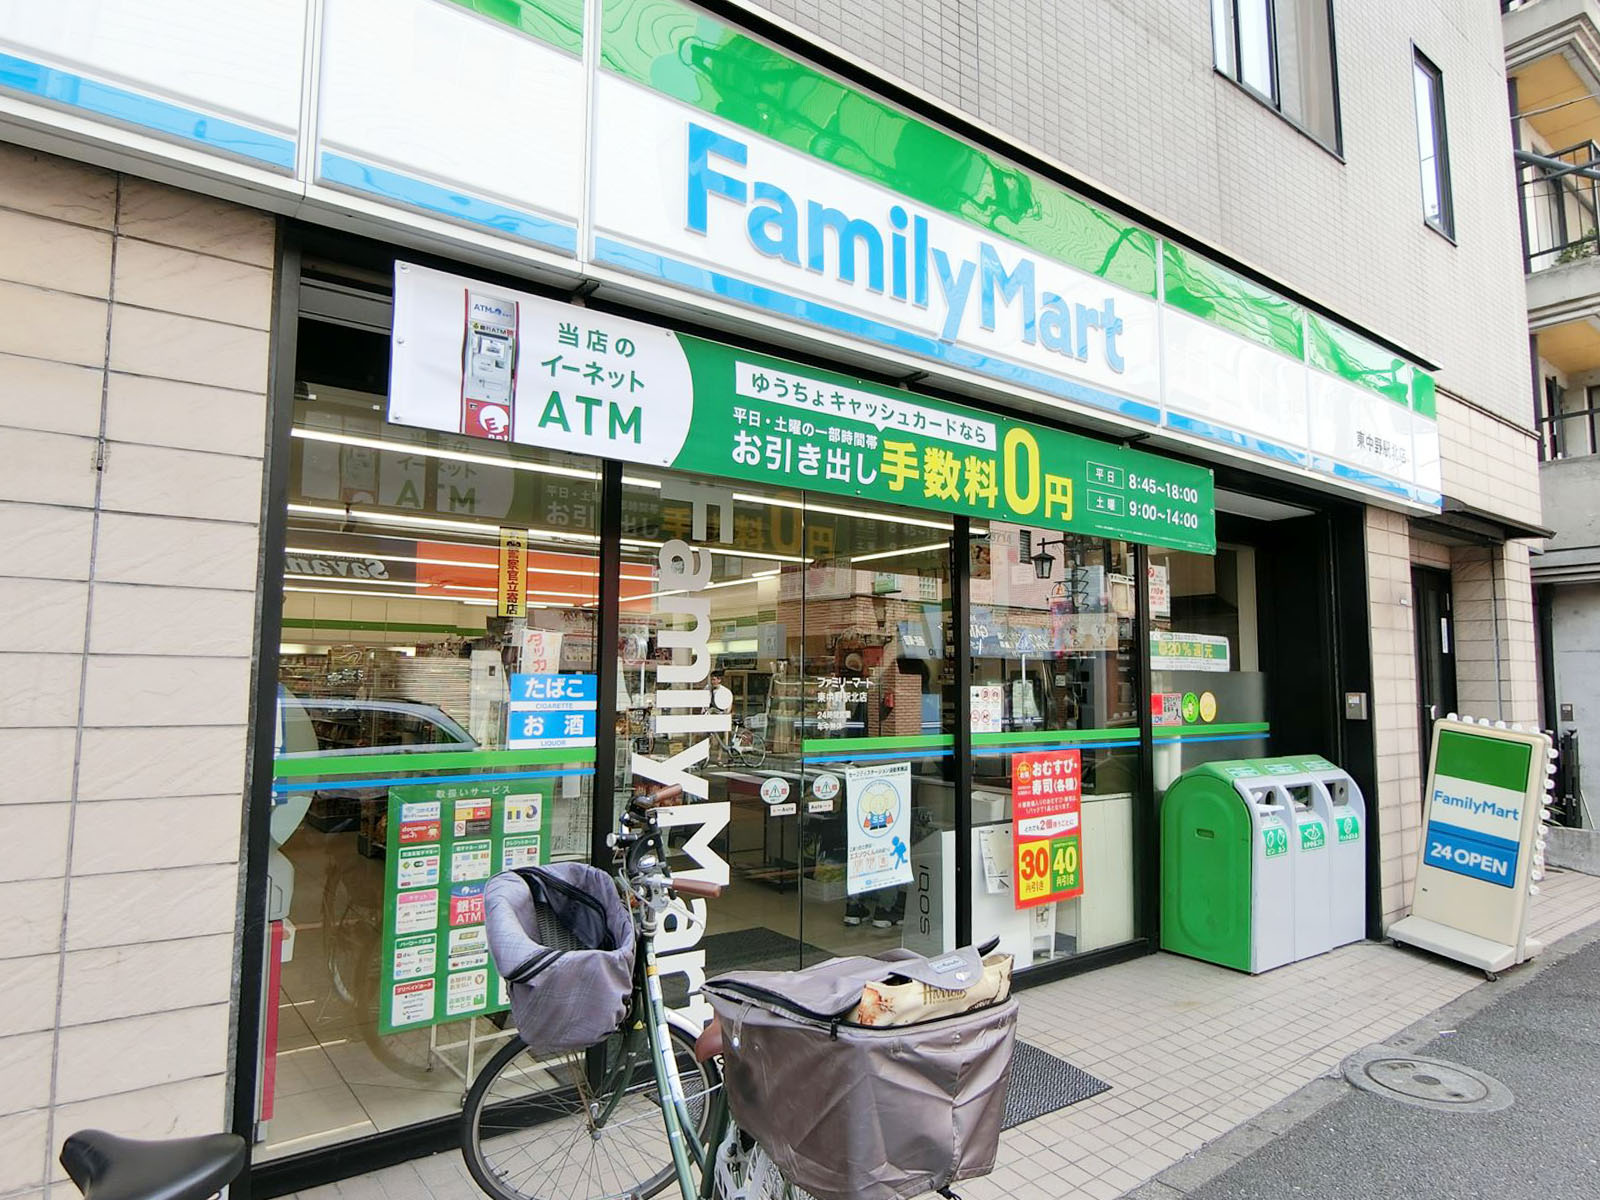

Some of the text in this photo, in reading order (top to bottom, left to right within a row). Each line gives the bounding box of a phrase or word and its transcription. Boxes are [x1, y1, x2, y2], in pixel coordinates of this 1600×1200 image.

[685, 121, 1125, 374] FamilyMart
[558, 321, 636, 358] 当店の
[541, 354, 645, 393] イーネット
[538, 390, 643, 445] ATM
[752, 373, 987, 443] ゆうちょキャッシュカードなら
[733, 406, 878, 450] 平日・土曜の一部時間帯
[731, 429, 878, 485] お引き出し
[1095, 467, 1115, 484] 平日
[1095, 495, 1116, 511] 土曜
[525, 677, 584, 699] たばこ
[817, 677, 873, 689] ファミリーマート
[1433, 789, 1519, 821] FamilyMart
[1021, 847, 1049, 881] 30
[1053, 846, 1078, 875] 40
[456, 911, 482, 925] ATM
